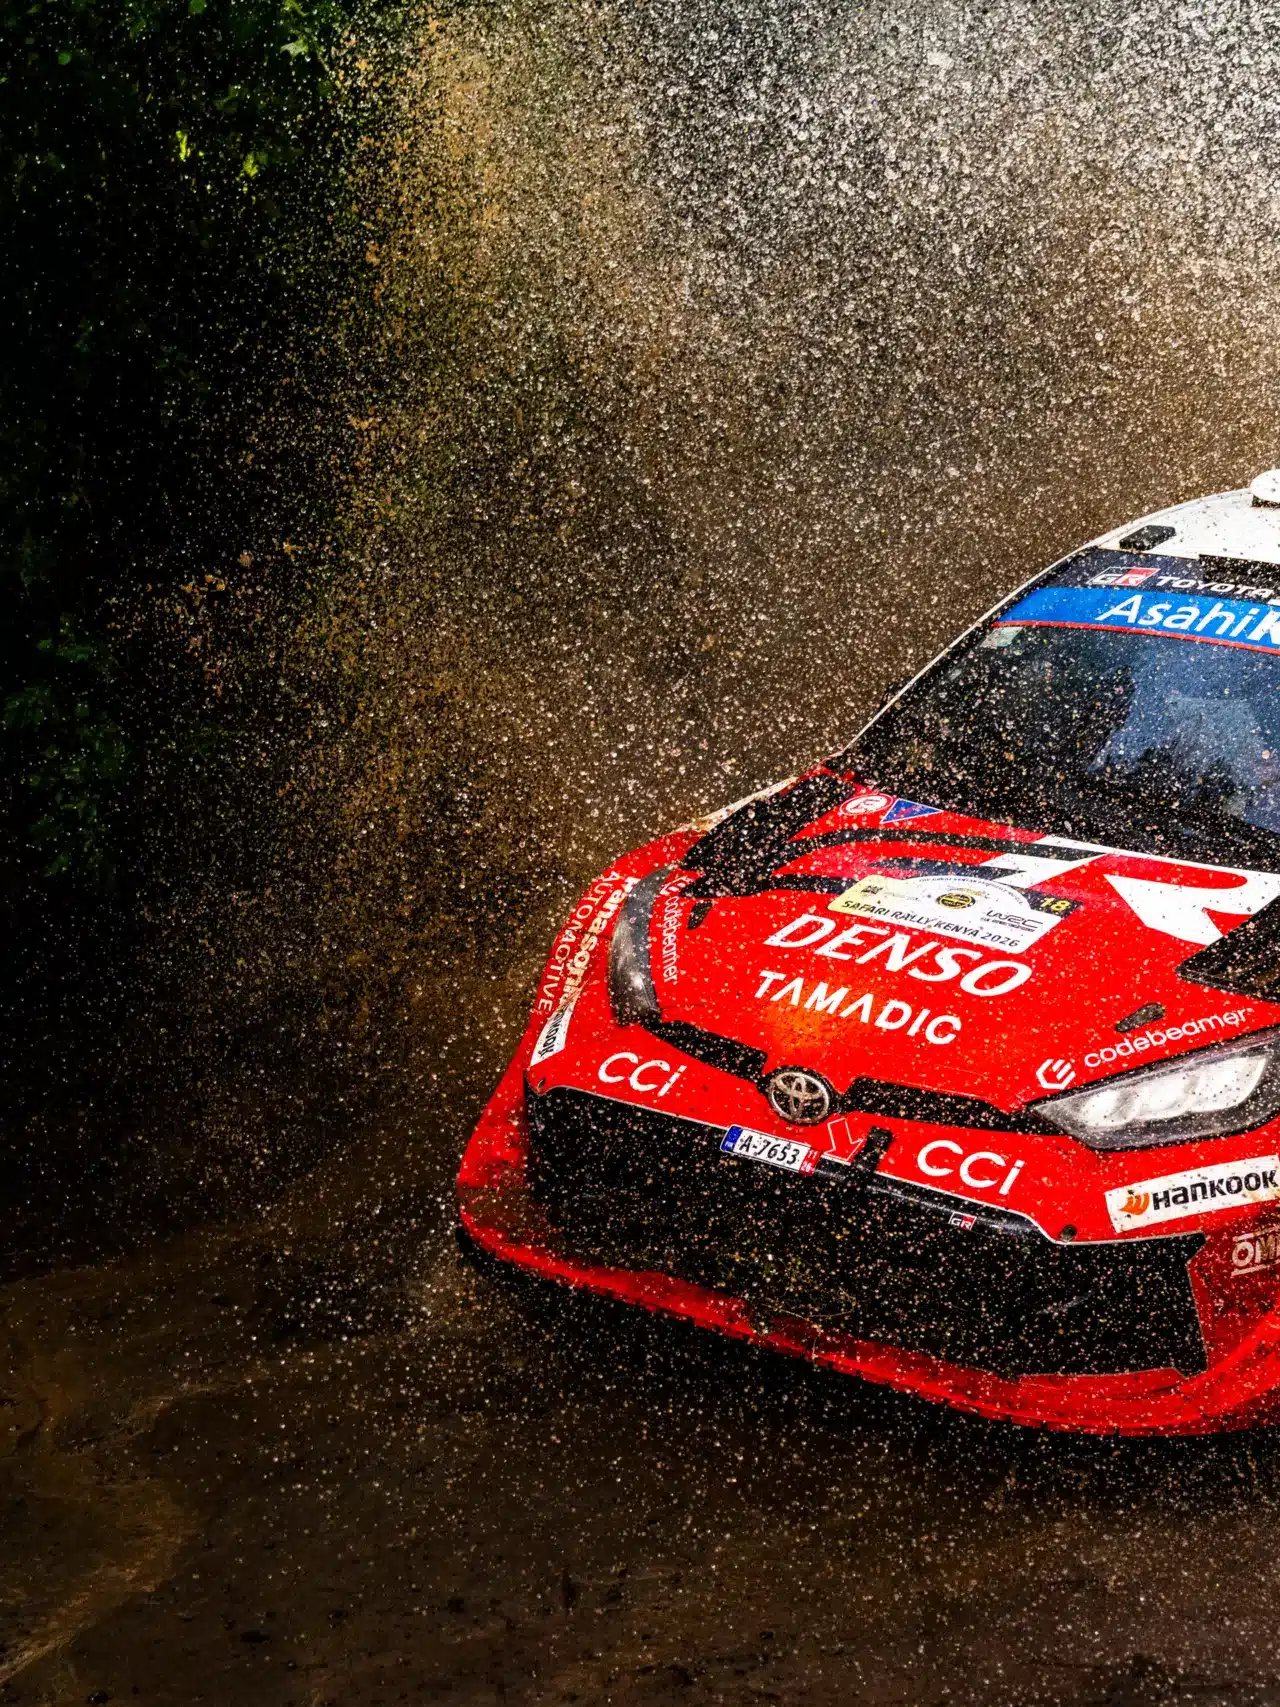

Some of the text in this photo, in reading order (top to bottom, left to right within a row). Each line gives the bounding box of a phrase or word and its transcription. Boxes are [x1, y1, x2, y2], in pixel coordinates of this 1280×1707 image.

[1156, 575, 1275, 599] TOYOTA
[841, 900, 890, 917] SAFARI
[891, 911, 936, 929] RALLY
[935, 920, 979, 938] KENYA
[982, 932, 1020, 947] 2026
[987, 909, 1043, 928] WRC
[1040, 897, 1071, 911] 18
[661, 895, 680, 984] codebeamer
[763, 914, 1032, 997] DENSO
[754, 970, 962, 1045] TAMADIC
[1083, 1008, 1247, 1069] codebeamer
[739, 1134, 800, 1165] A-7653
[949, 1214, 976, 1230] GR
